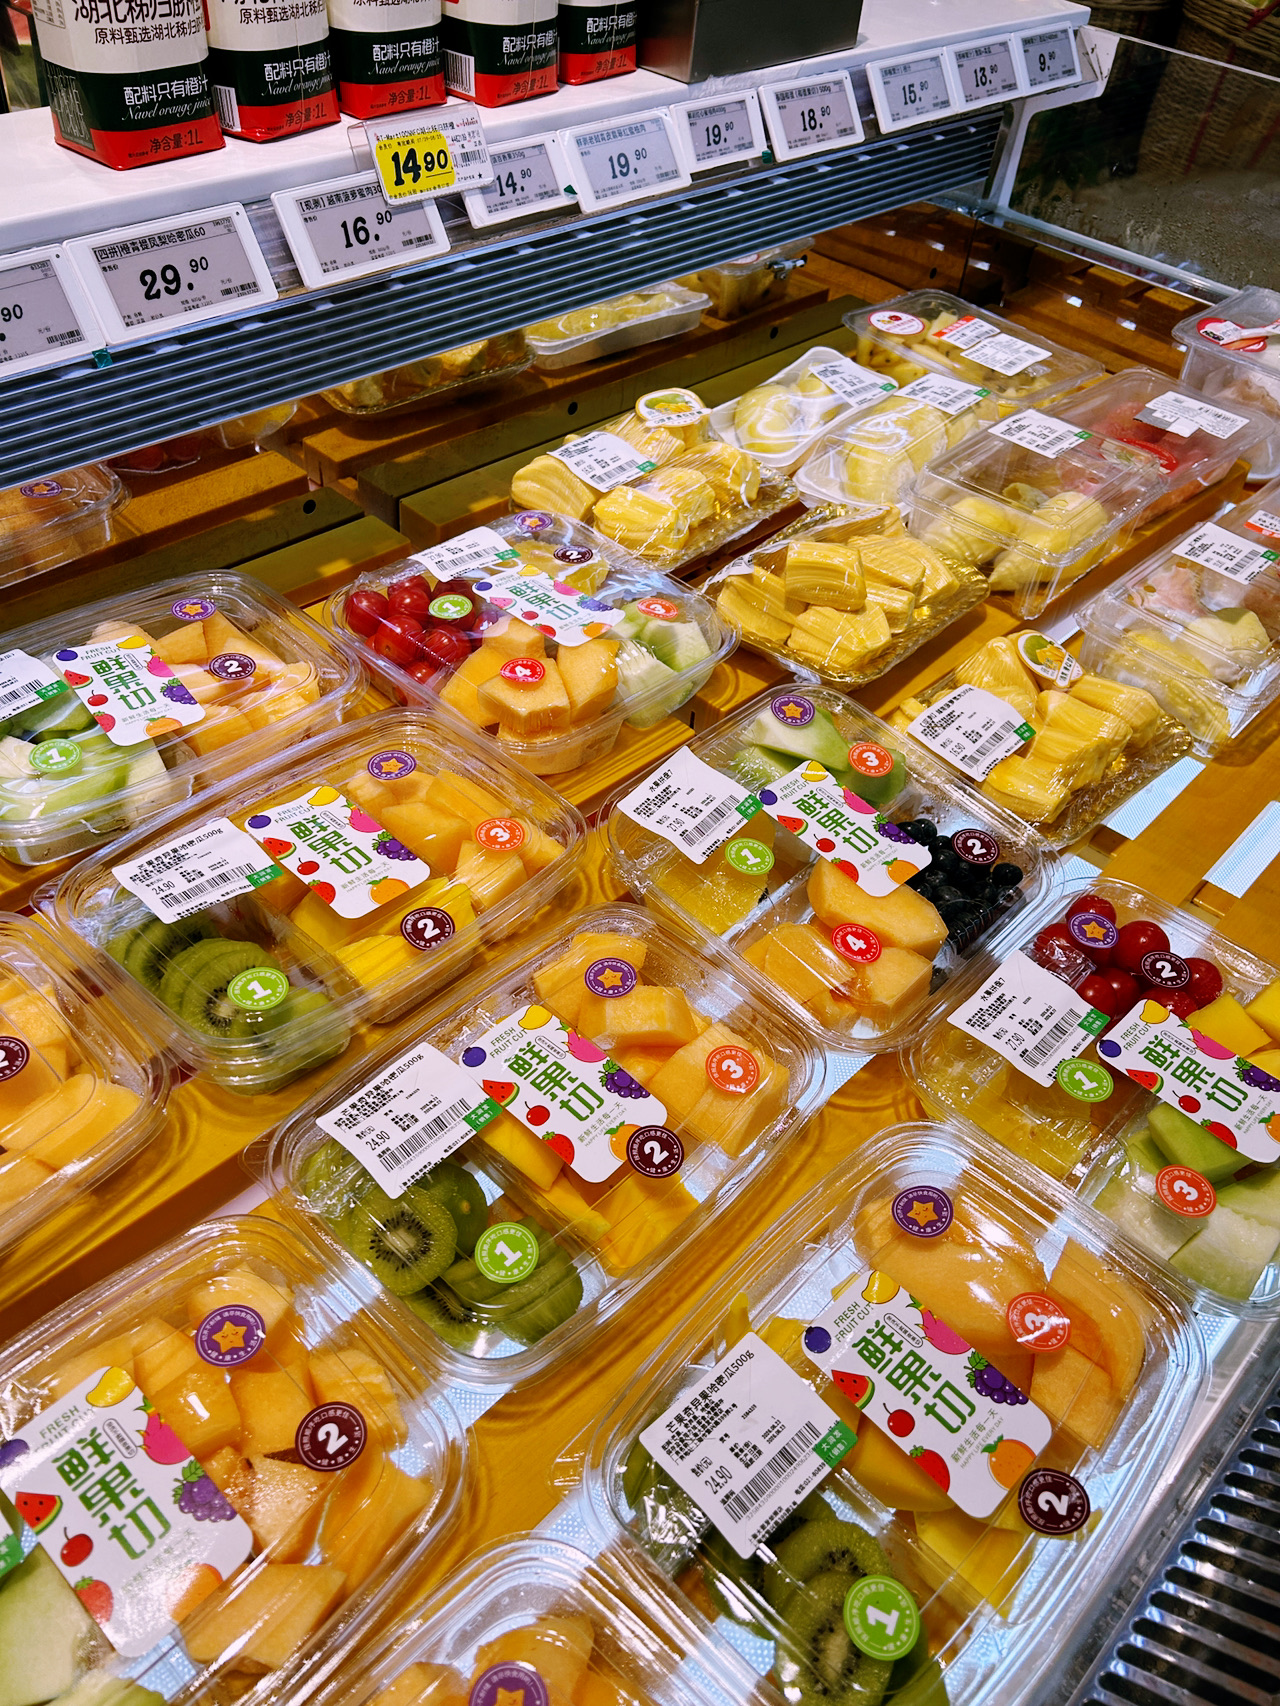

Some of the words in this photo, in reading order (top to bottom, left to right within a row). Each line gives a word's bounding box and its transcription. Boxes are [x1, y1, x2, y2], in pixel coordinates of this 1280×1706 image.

[372, 36, 439, 61] 配料只有橙汁
[497, 53, 526, 66] Navel
[264, 50, 331, 81] 配料只有橙汁
[368, 60, 399, 75] Navel
[398, 61, 425, 75] orange
[123, 74, 208, 106] 配料只有橙汁
[261, 79, 293, 96] Navel
[293, 78, 320, 93] orange
[388, 85, 431, 105] 净含量:1L
[122, 104, 157, 121] Navel
[159, 101, 192, 117] orange
[285, 103, 327, 127] 净含量:1L
[801, 105, 831, 132] 18.90
[150, 128, 203, 153] 净含量:1L
[705, 121, 734, 147] 19.90
[608, 147, 647, 179] 19.90
[496, 168, 532, 197] 14.90
[341, 209, 393, 249] 16.90
[139, 256, 208, 300] 29.90
[566, 550, 582, 560] 2
[442, 602, 461, 613] 1
[506, 581, 580, 621] 鲜果切
[650, 604, 666, 614] 3
[224, 660, 243, 674] 2
[515, 665, 531, 678] 4
[92, 654, 157, 710] 鲜果切
[46, 748, 66, 764] 1
[862, 752, 879, 766] 3
[646, 768, 675, 792] 水果拼盘7
[779, 777, 800, 792] FRESH
[780, 788, 799, 801] FRUIT
[797, 780, 810, 792] CUT
[274, 813, 296, 825] FRUIT
[298, 805, 316, 817] CUT
[277, 804, 305, 818] FRESH
[792, 789, 879, 854] 鲜果切
[287, 814, 373, 875] 鲜果切
[490, 826, 510, 842] 3
[967, 838, 986, 855] 2
[741, 848, 761, 865] 1
[860, 843, 895, 868] 新鲜生活每一天
[150, 880, 176, 895] 24.90
[340, 861, 390, 890] 新鲜生活每一天
[417, 918, 441, 940] 2
[845, 933, 867, 951] 4
[1155, 961, 1176, 979] 2
[247, 980, 271, 1000] 1
[979, 976, 1007, 1002] 水果拼盘7
[489, 1038, 512, 1058] FRUIT
[512, 1029, 529, 1044] CUT
[490, 1026, 517, 1047] FRESH
[1004, 1031, 1026, 1051] 27.90
[1120, 1022, 1140, 1041] FRESH
[1123, 1033, 1141, 1051] FRUIT
[1138, 1022, 1152, 1038] CUT
[722, 1058, 744, 1078] 3
[1138, 1035, 1249, 1113] 鲜果切
[340, 1051, 424, 1117] 芒果奇异果哈密瓜500g
[504, 1041, 604, 1121] 鲜果切
[1073, 1071, 1097, 1092] 1
[469, 1103, 489, 1121] 大润发
[578, 1101, 624, 1143] 新鲜生活每一天
[1233, 1094, 1268, 1131] 新鲜生活每一天
[365, 1129, 391, 1151] 24.90
[644, 1140, 669, 1165] 2
[1173, 1179, 1199, 1201] 3
[494, 1240, 523, 1266] 1
[833, 1301, 860, 1328] FRESH
[835, 1320, 858, 1343] FRUIT
[858, 1302, 874, 1321] CUT
[852, 1320, 976, 1434] 鲜果切
[664, 1348, 755, 1435] 芒果奇异果哈密瓜500g
[39, 1405, 80, 1439] FRESH
[317, 1423, 349, 1455] 2
[820, 1428, 842, 1451] 大润发
[951, 1408, 998, 1464] 新鲜生活每一天
[960, 1450, 975, 1470] HAPPY
[982, 1428, 996, 1446] EVERY
[994, 1417, 1005, 1431] DAY
[690, 1454, 713, 1478] 售价(元)
[703, 1463, 733, 1495] 24.90
[52, 1426, 171, 1559] 鲜果切
[1038, 1490, 1069, 1516] 2
[865, 1605, 899, 1636] 1
